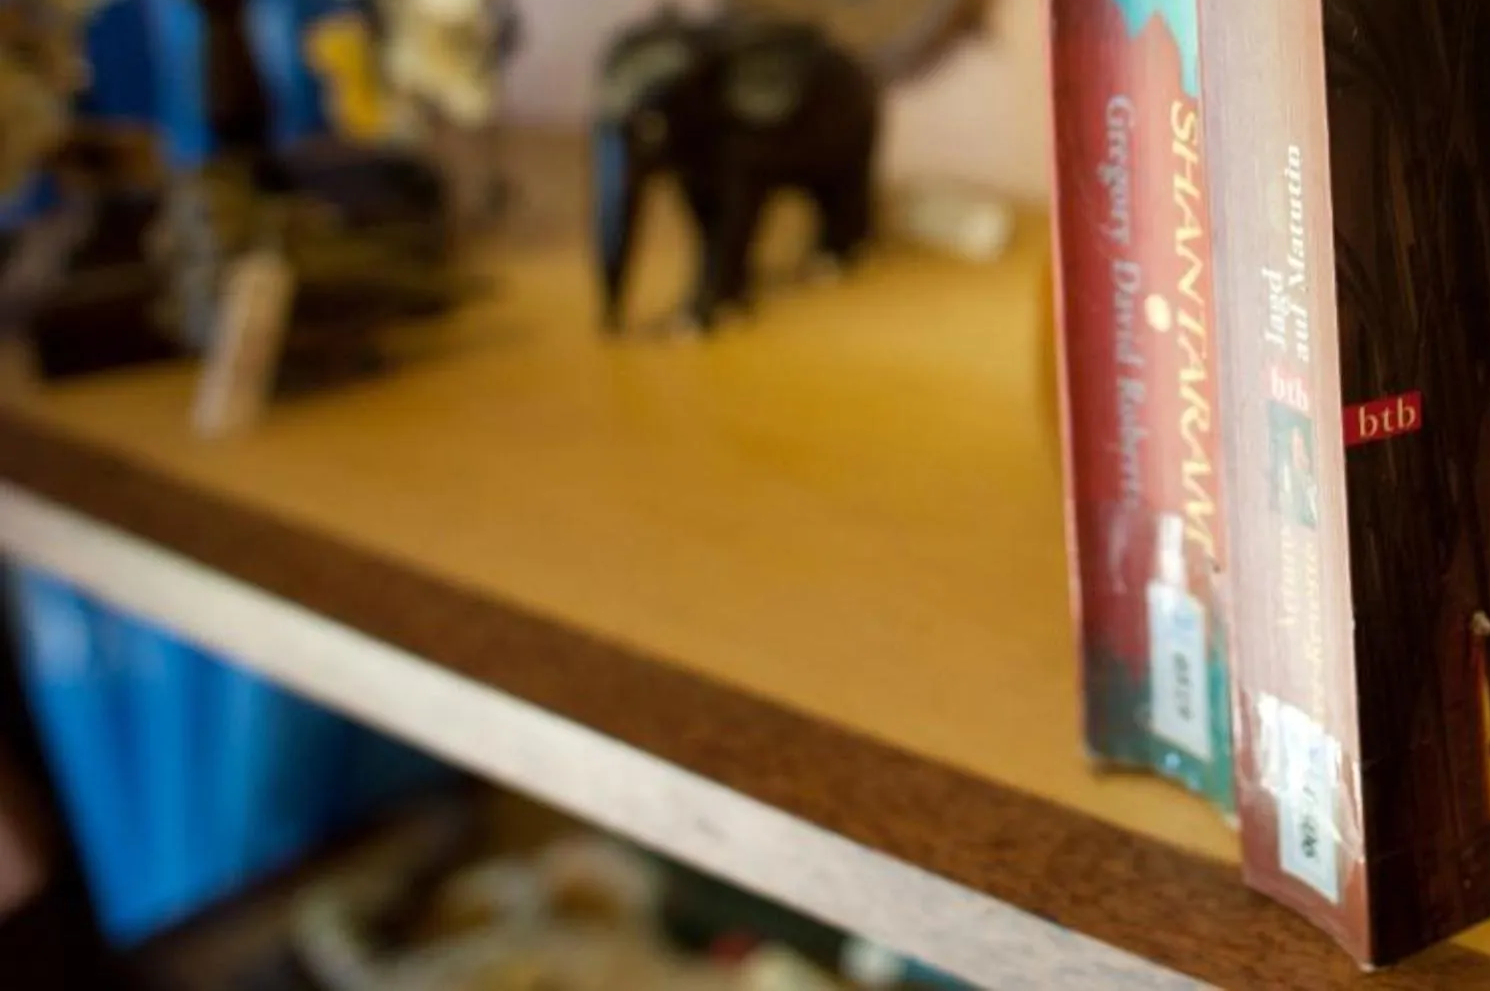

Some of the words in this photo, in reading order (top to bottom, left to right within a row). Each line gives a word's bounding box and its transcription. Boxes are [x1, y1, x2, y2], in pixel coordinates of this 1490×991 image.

[1096, 94, 1135, 248] Gregory
[1111, 259, 1146, 367] David
[1170, 100, 1214, 558] SHANTARAM
[1261, 265, 1290, 349] Jagd
[1358, 397, 1416, 437] btb
